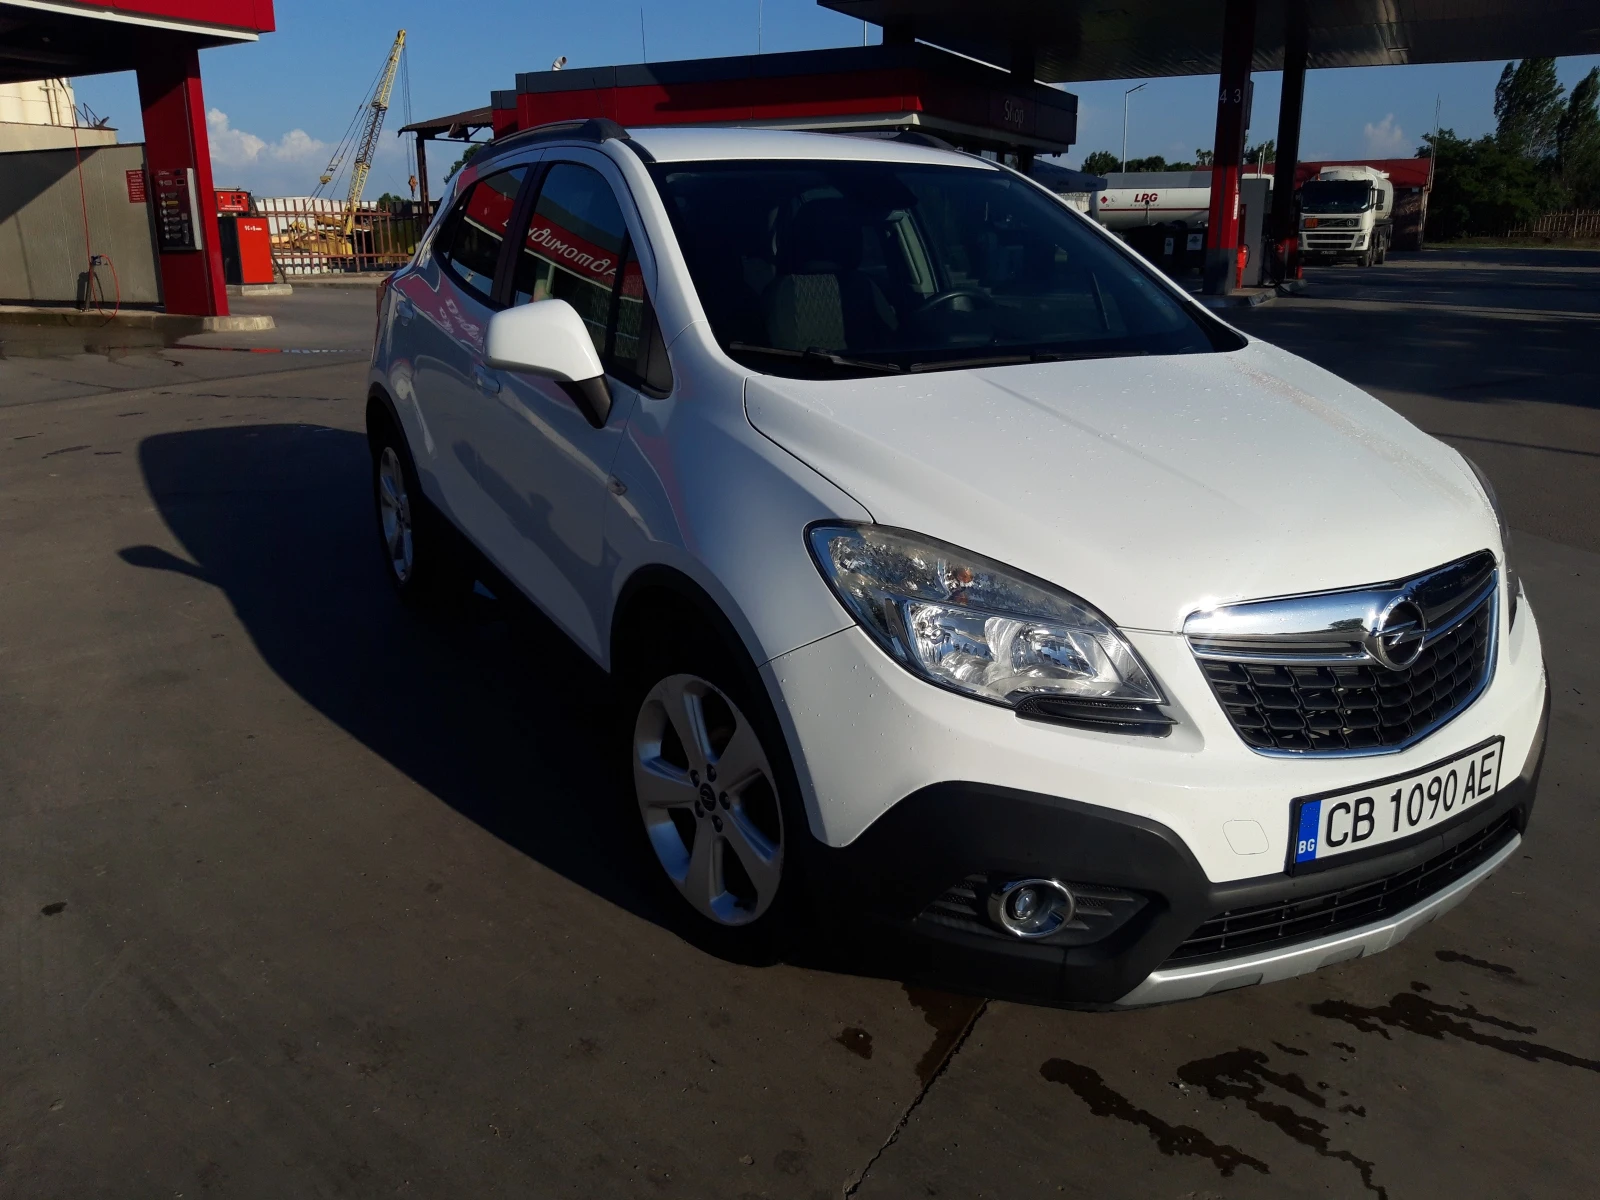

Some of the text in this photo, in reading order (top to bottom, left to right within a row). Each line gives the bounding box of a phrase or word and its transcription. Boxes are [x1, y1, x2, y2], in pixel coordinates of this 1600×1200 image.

[1219, 88, 1242, 104] 4 3
[1003, 99, 1025, 128] Shop
[1134, 193, 1158, 203] LPG
[1325, 750, 1496, 848] CB 1090 AE
[1298, 838, 1316, 854] BG
